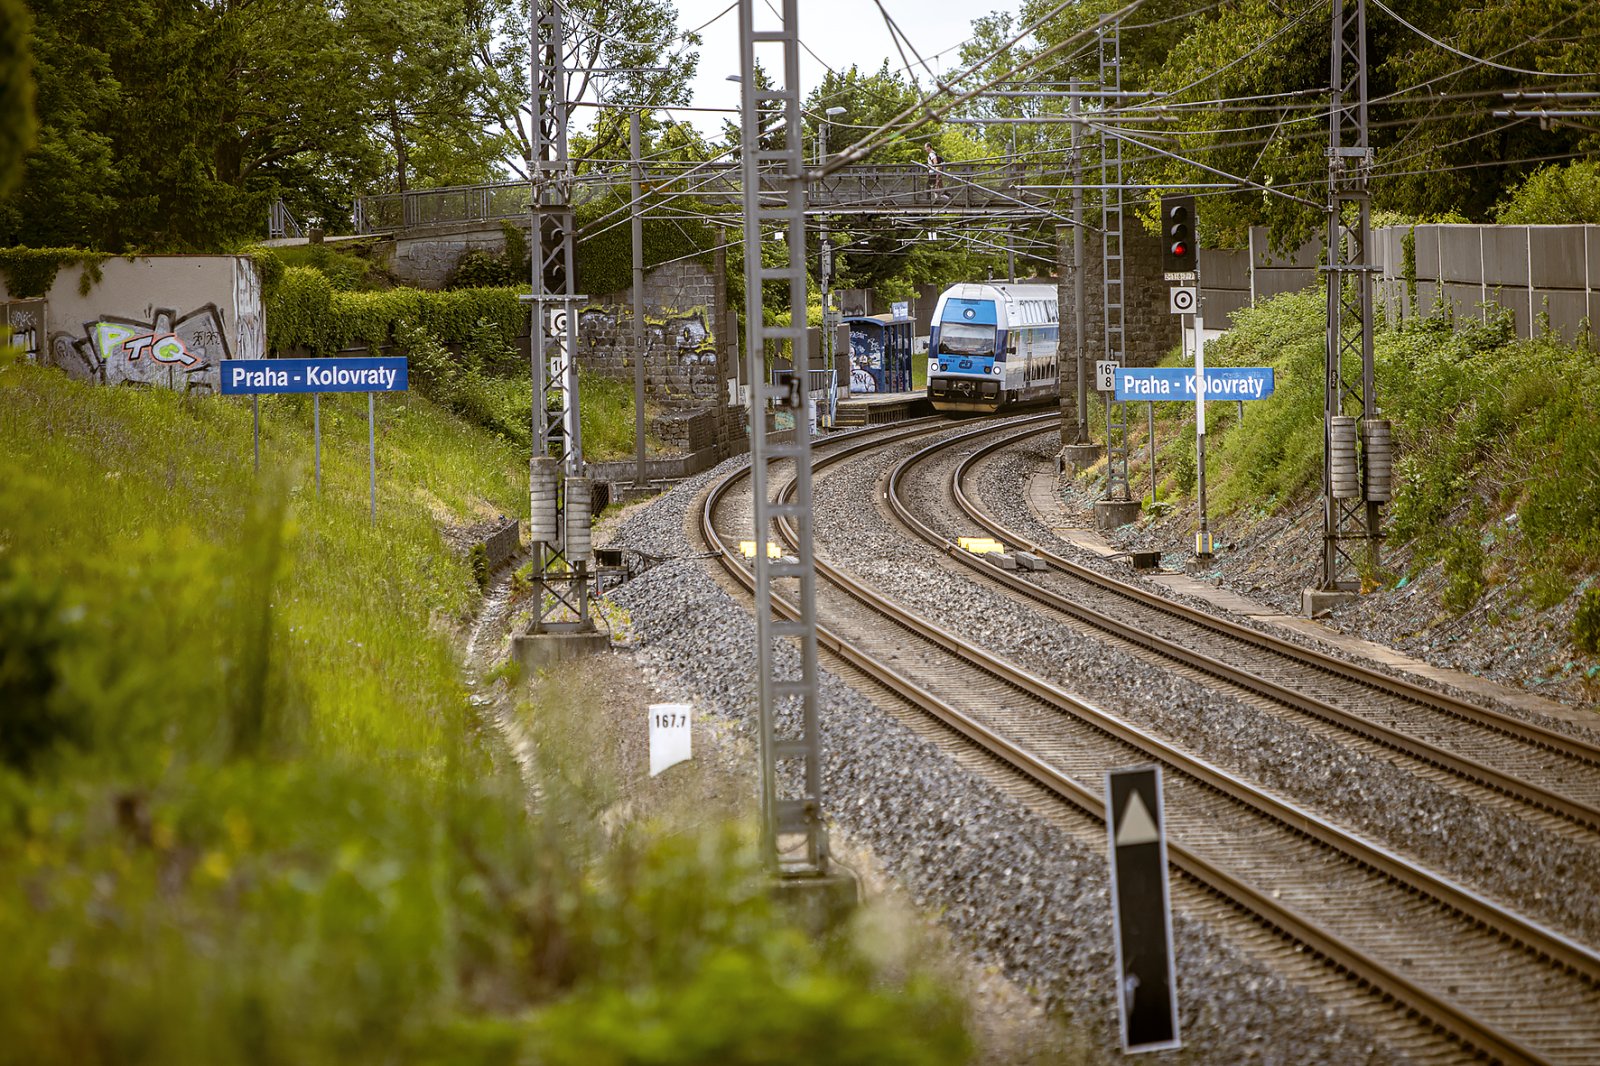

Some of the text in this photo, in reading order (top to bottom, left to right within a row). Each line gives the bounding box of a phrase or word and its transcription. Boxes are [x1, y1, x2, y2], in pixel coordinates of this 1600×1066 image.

[1099, 364, 1117, 375] 167
[232, 366, 288, 387] Praha
[306, 365, 397, 389] Kolovraty
[1105, 377, 1112, 388] 8
[1124, 375, 1170, 394] Praha
[655, 714, 686, 728] 167.7
